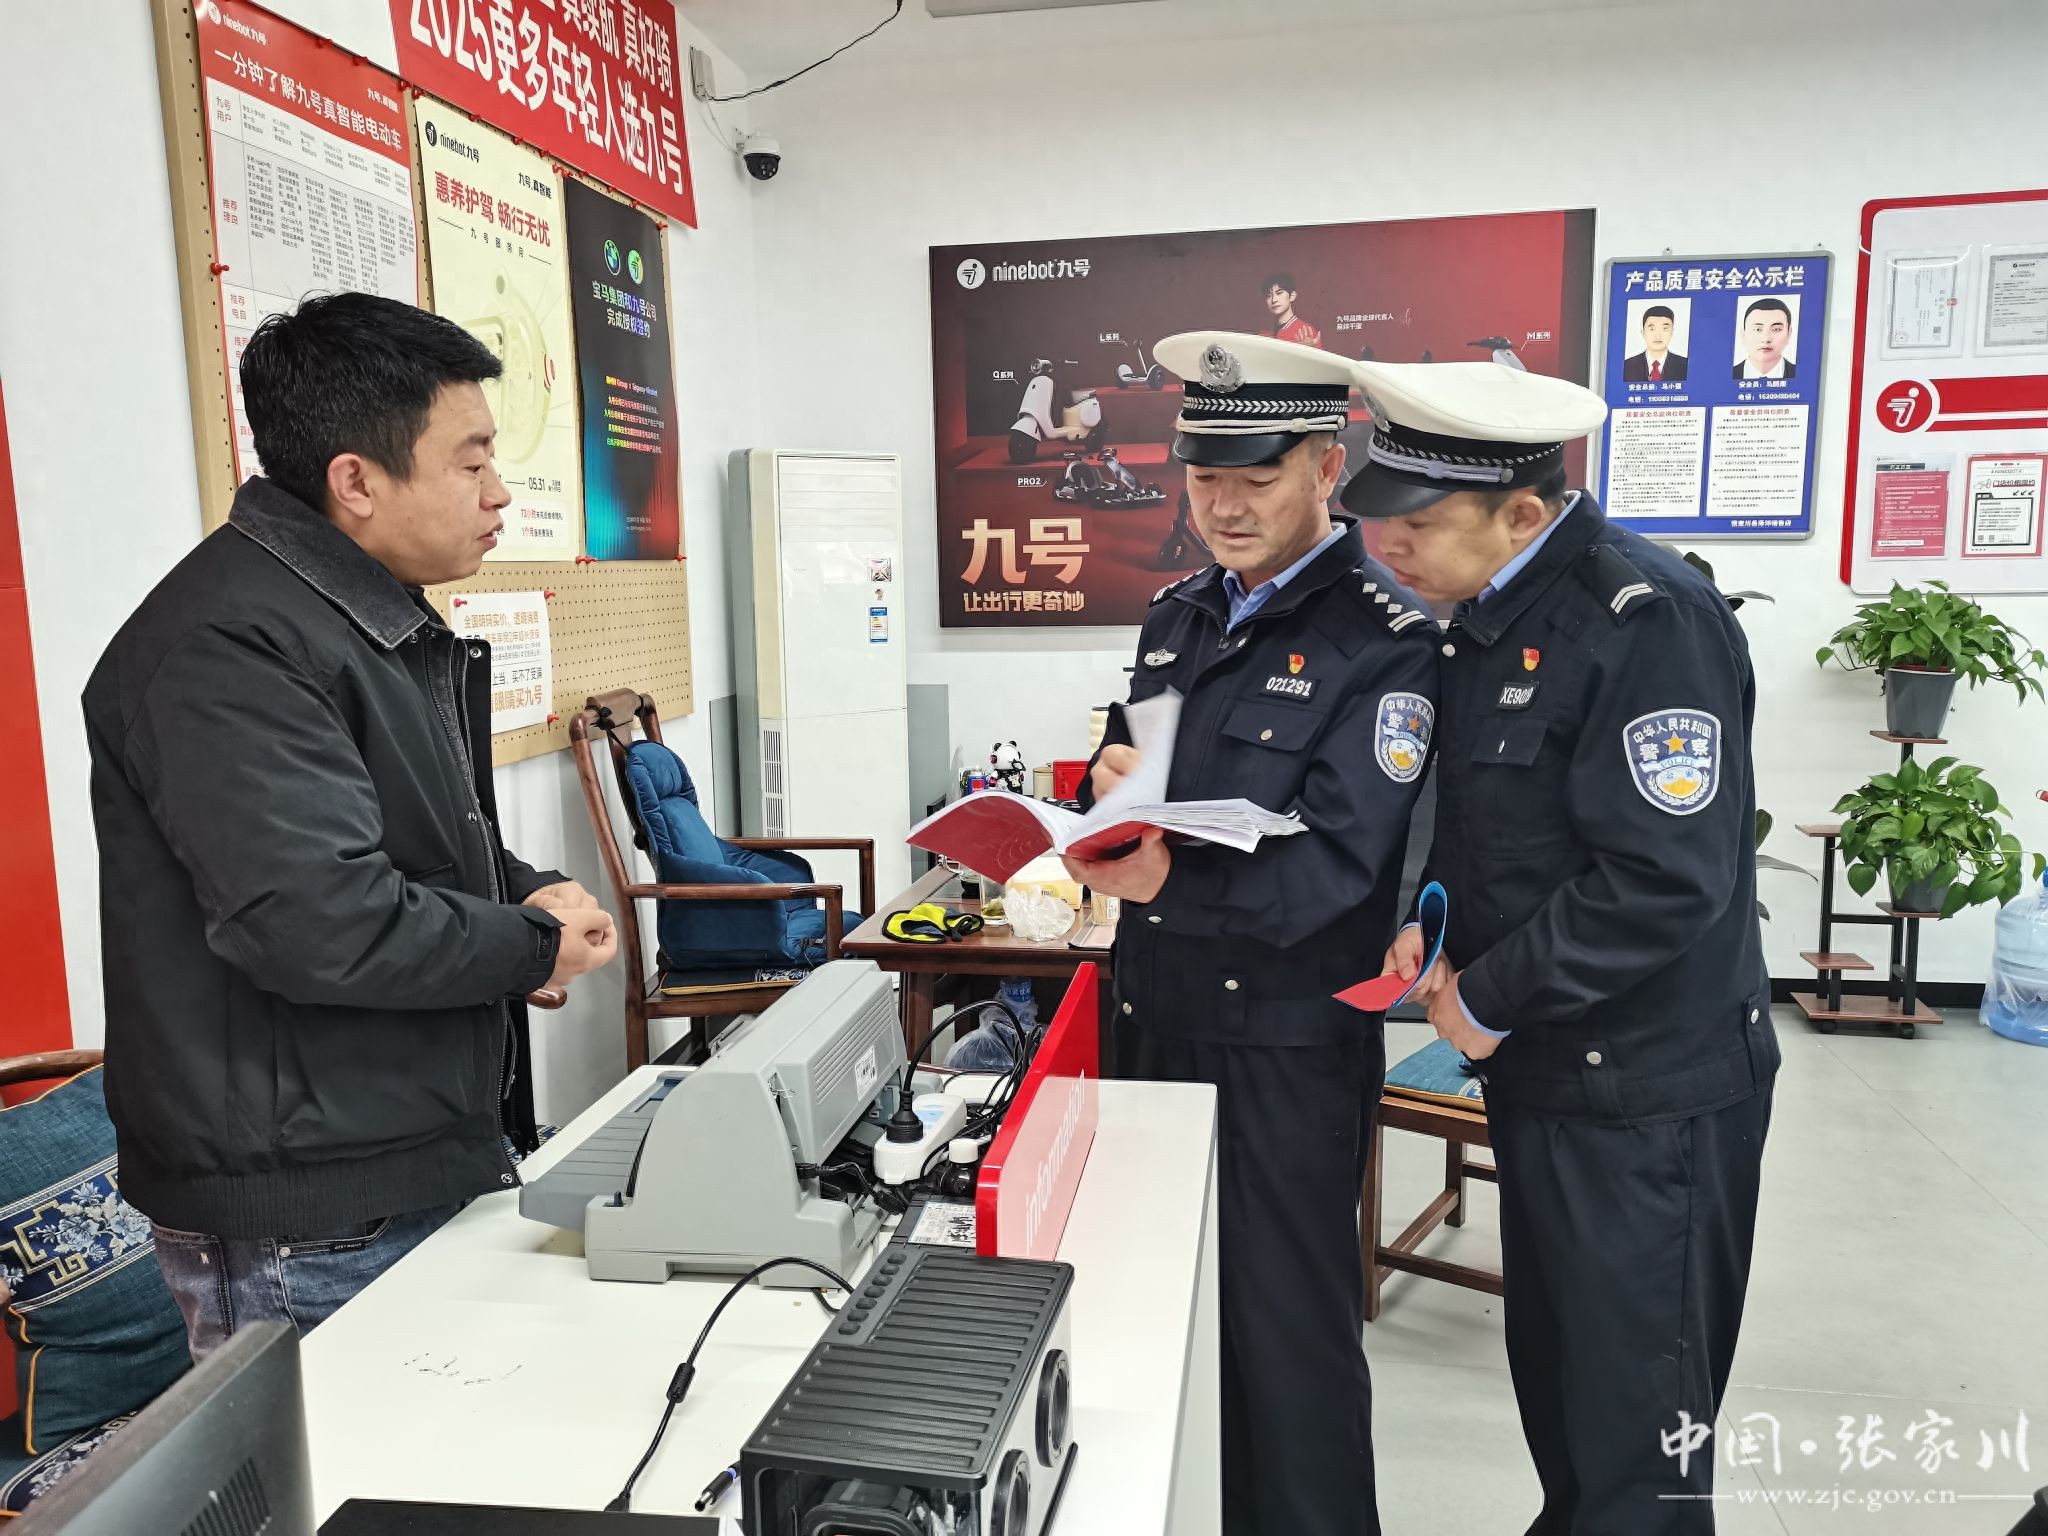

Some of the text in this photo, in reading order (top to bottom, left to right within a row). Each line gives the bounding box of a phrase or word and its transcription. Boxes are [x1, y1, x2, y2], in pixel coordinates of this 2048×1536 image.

[621, 0, 673, 98] 真好骑
[214, 49, 402, 151] 一分钟了解九号真智能电动车
[410, 0, 683, 195] 2025更多年轻人选九号
[435, 171, 494, 223] 惠养护驾
[498, 200, 551, 248] 畅行无忧
[1624, 265, 1805, 292] 产品质量安全公示栏
[592, 280, 657, 321] 宝马集团和九号公司
[1017, 477, 1042, 486] PRO2
[960, 518, 1090, 585] 九号
[963, 590, 1085, 612] 让出行更奇妙
[491, 684, 542, 713] 眼睛买九号
[1266, 676, 1312, 697] 021291
[1633, 717, 1712, 744] 中华人民共和国
[1639, 738, 1710, 762] 警 察
